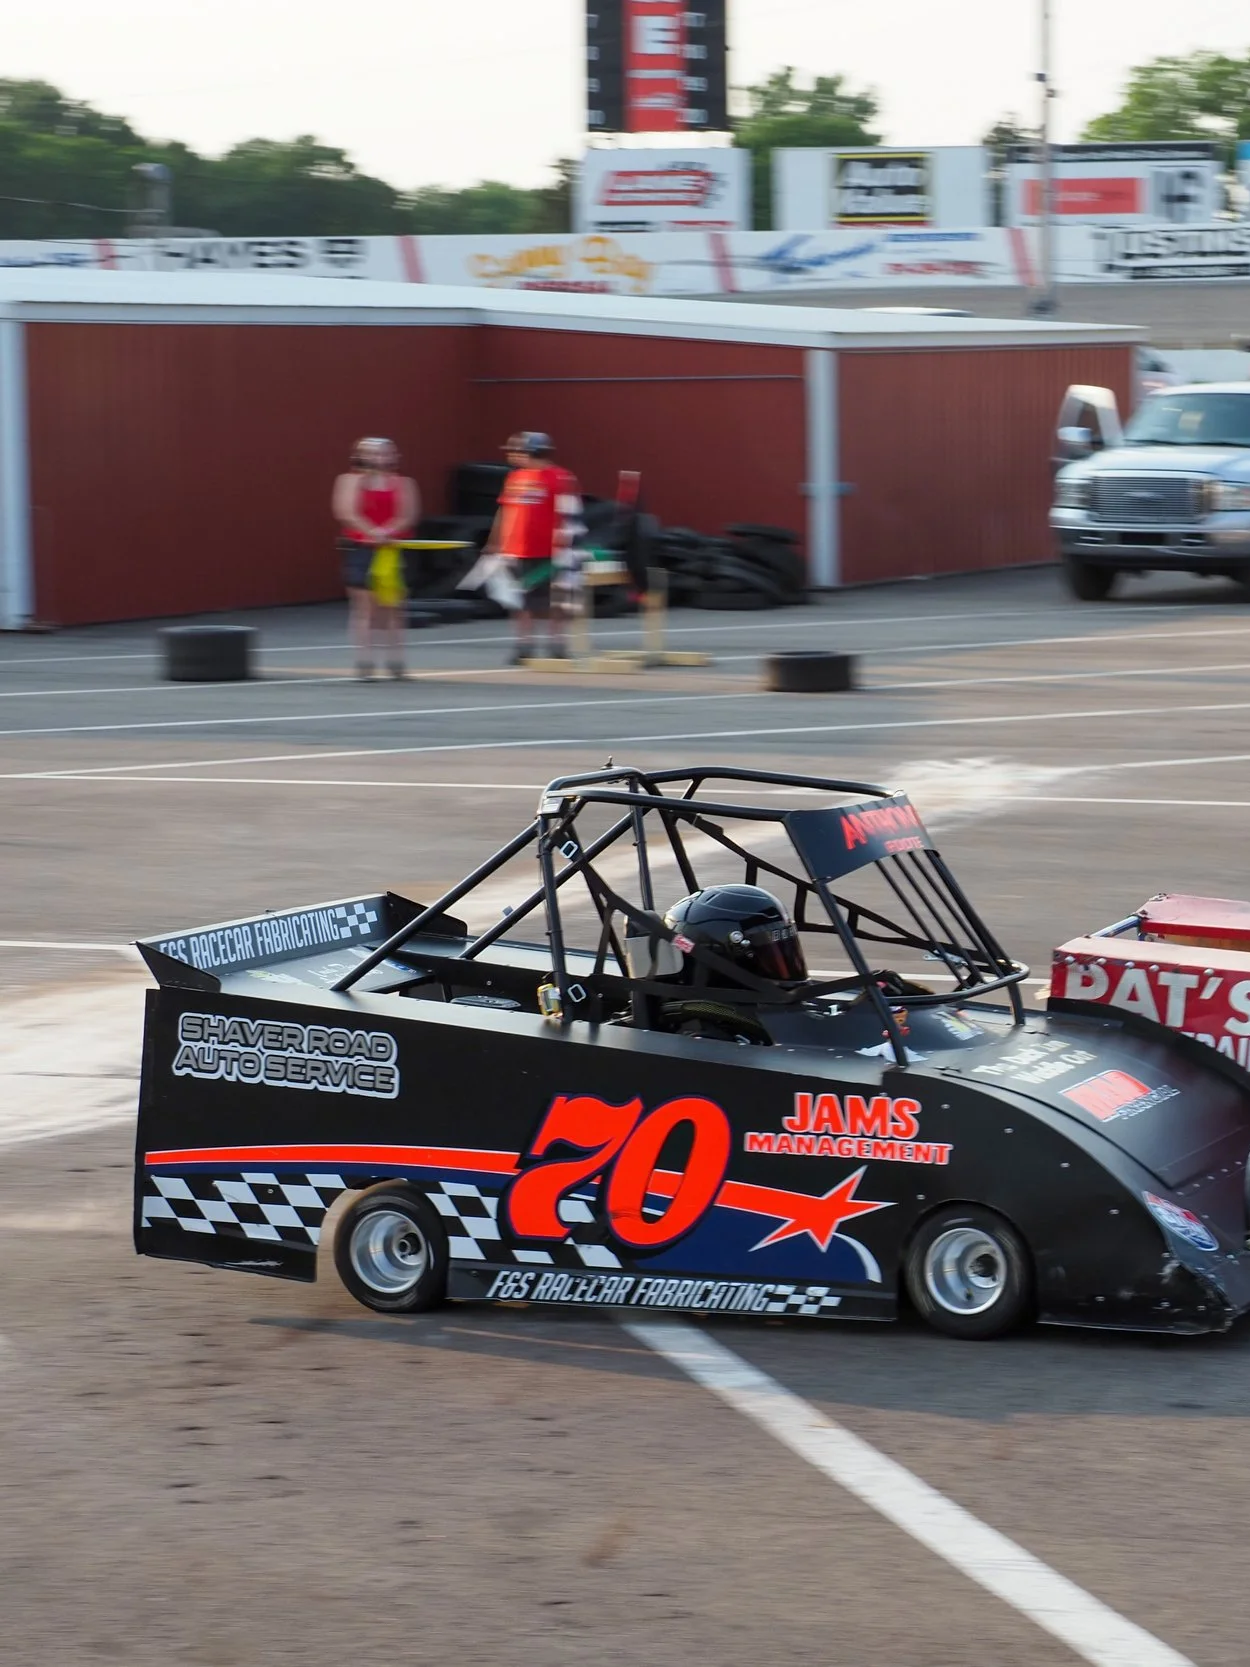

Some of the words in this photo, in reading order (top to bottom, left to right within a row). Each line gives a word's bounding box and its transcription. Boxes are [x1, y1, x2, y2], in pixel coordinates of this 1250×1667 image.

[189, 925, 256, 970] RACECAR
[254, 908, 340, 957] FABRICATING
[179, 1014, 304, 1051] SHAVER
[305, 1027, 399, 1062] ROAD
[173, 1046, 263, 1081] AUTO
[263, 1056, 400, 1098] SERVICE
[783, 1092, 922, 1139] JAMS
[507, 1095, 731, 1249] 70
[744, 1132, 954, 1166] MANAGEMENT
[532, 1272, 636, 1306] RACECAR
[630, 1278, 774, 1313] FABRICATING
